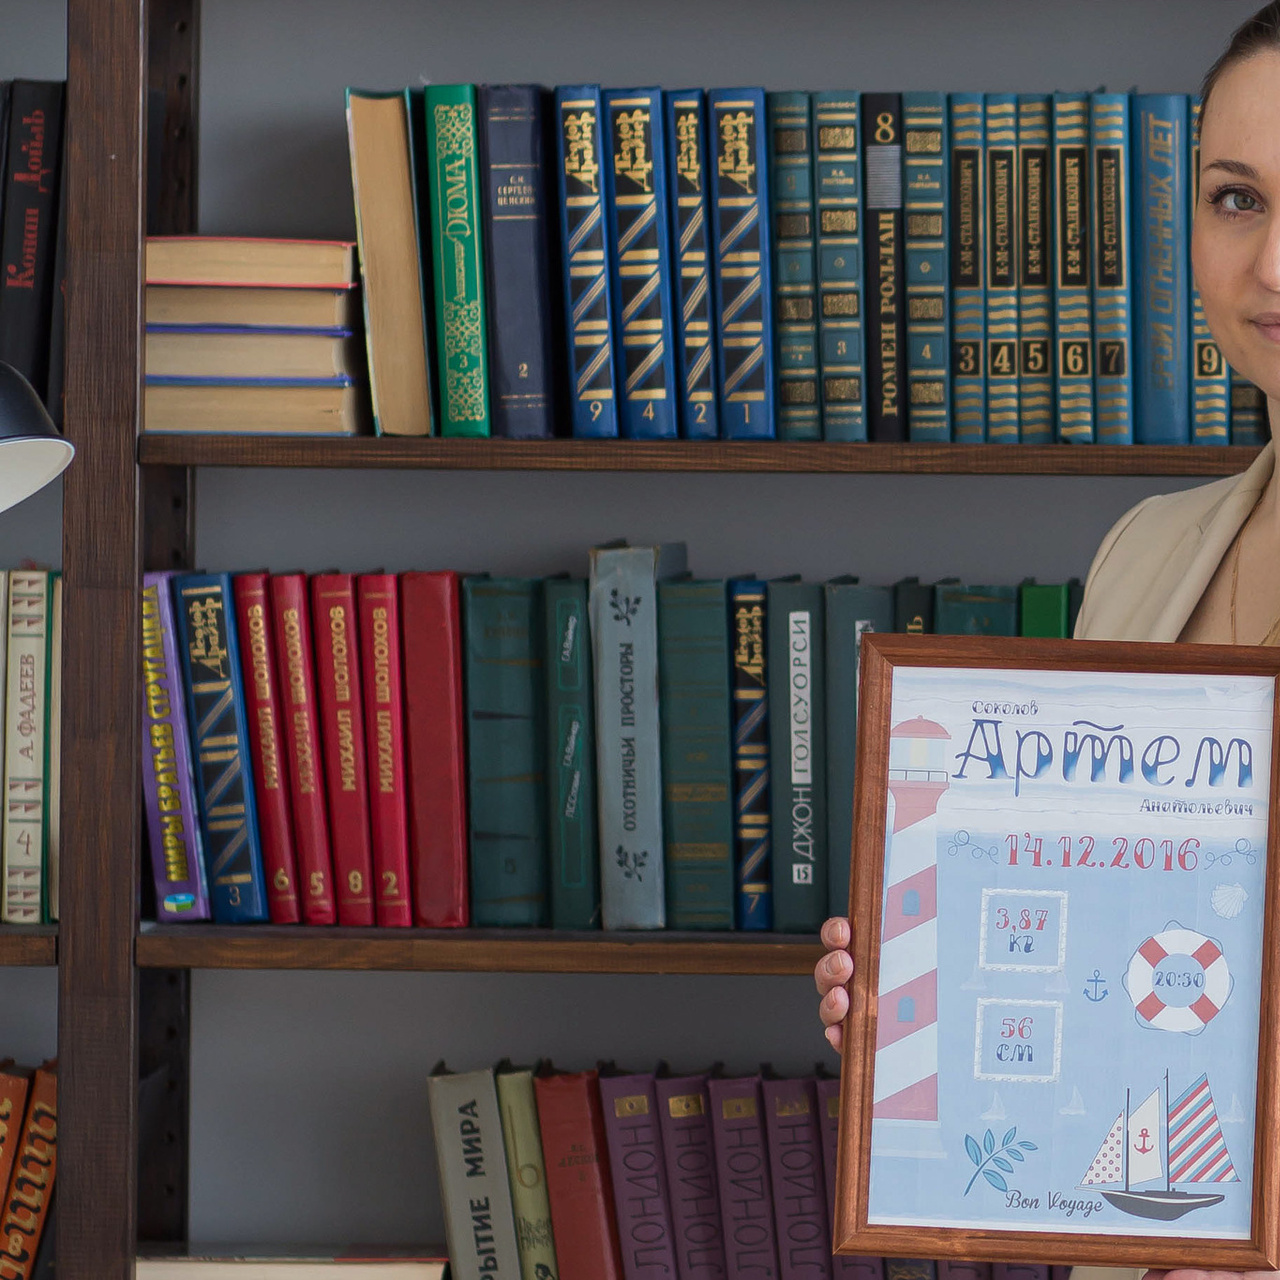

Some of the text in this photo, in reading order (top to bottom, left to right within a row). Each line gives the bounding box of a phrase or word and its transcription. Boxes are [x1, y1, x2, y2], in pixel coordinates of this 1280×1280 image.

[875, 113, 895, 143] 8
[1149, 114, 1174, 166] ЛЕТ
[445, 156, 470, 238] ДЮМА
[881, 322, 898, 417] РОМЕН
[994, 346, 1010, 372] 4
[1028, 344, 1043, 370] 5
[1066, 345, 1082, 372] 6
[1202, 345, 1218, 373] 9
[590, 403, 602, 422] 9
[642, 403, 654, 420] 4
[694, 404, 706, 423] 2
[742, 404, 750, 423] 1
[17, 653, 36, 739] ФАДЕЕВ
[330, 605, 356, 792] МИХАИЛ ШОЛОХОВ
[373, 607, 393, 793] МИХАИЛ ШОЛОХОВ
[972, 699, 1039, 716] Соколов
[620, 641, 638, 833] ОХОТНИЧЬИ ПРОСТОРЫ
[792, 617, 815, 862] ДЖОН ГОЛСУОРСИ
[151, 723, 181, 813] БРАТЬЕВ
[951, 718, 1254, 797] Артем
[1140, 798, 1255, 816] Анатольевич
[16, 829, 31, 855] 4
[159, 815, 189, 882] МИРЫ
[1005, 832, 1202, 873] 14.12.2016
[348, 871, 361, 894] 8
[382, 871, 398, 895] 2
[996, 907, 1049, 933] 3,87
[1154, 971, 1205, 989] 20:30
[1000, 1017, 1033, 1039] 56
[996, 1043, 1034, 1064] см
[457, 1098, 487, 1179] МИРА
[620, 1123, 671, 1273] ЛОНДОН
[779, 1123, 826, 1273] ЛОНДОН
[1006, 1190, 1105, 1216] Bon Voyage
